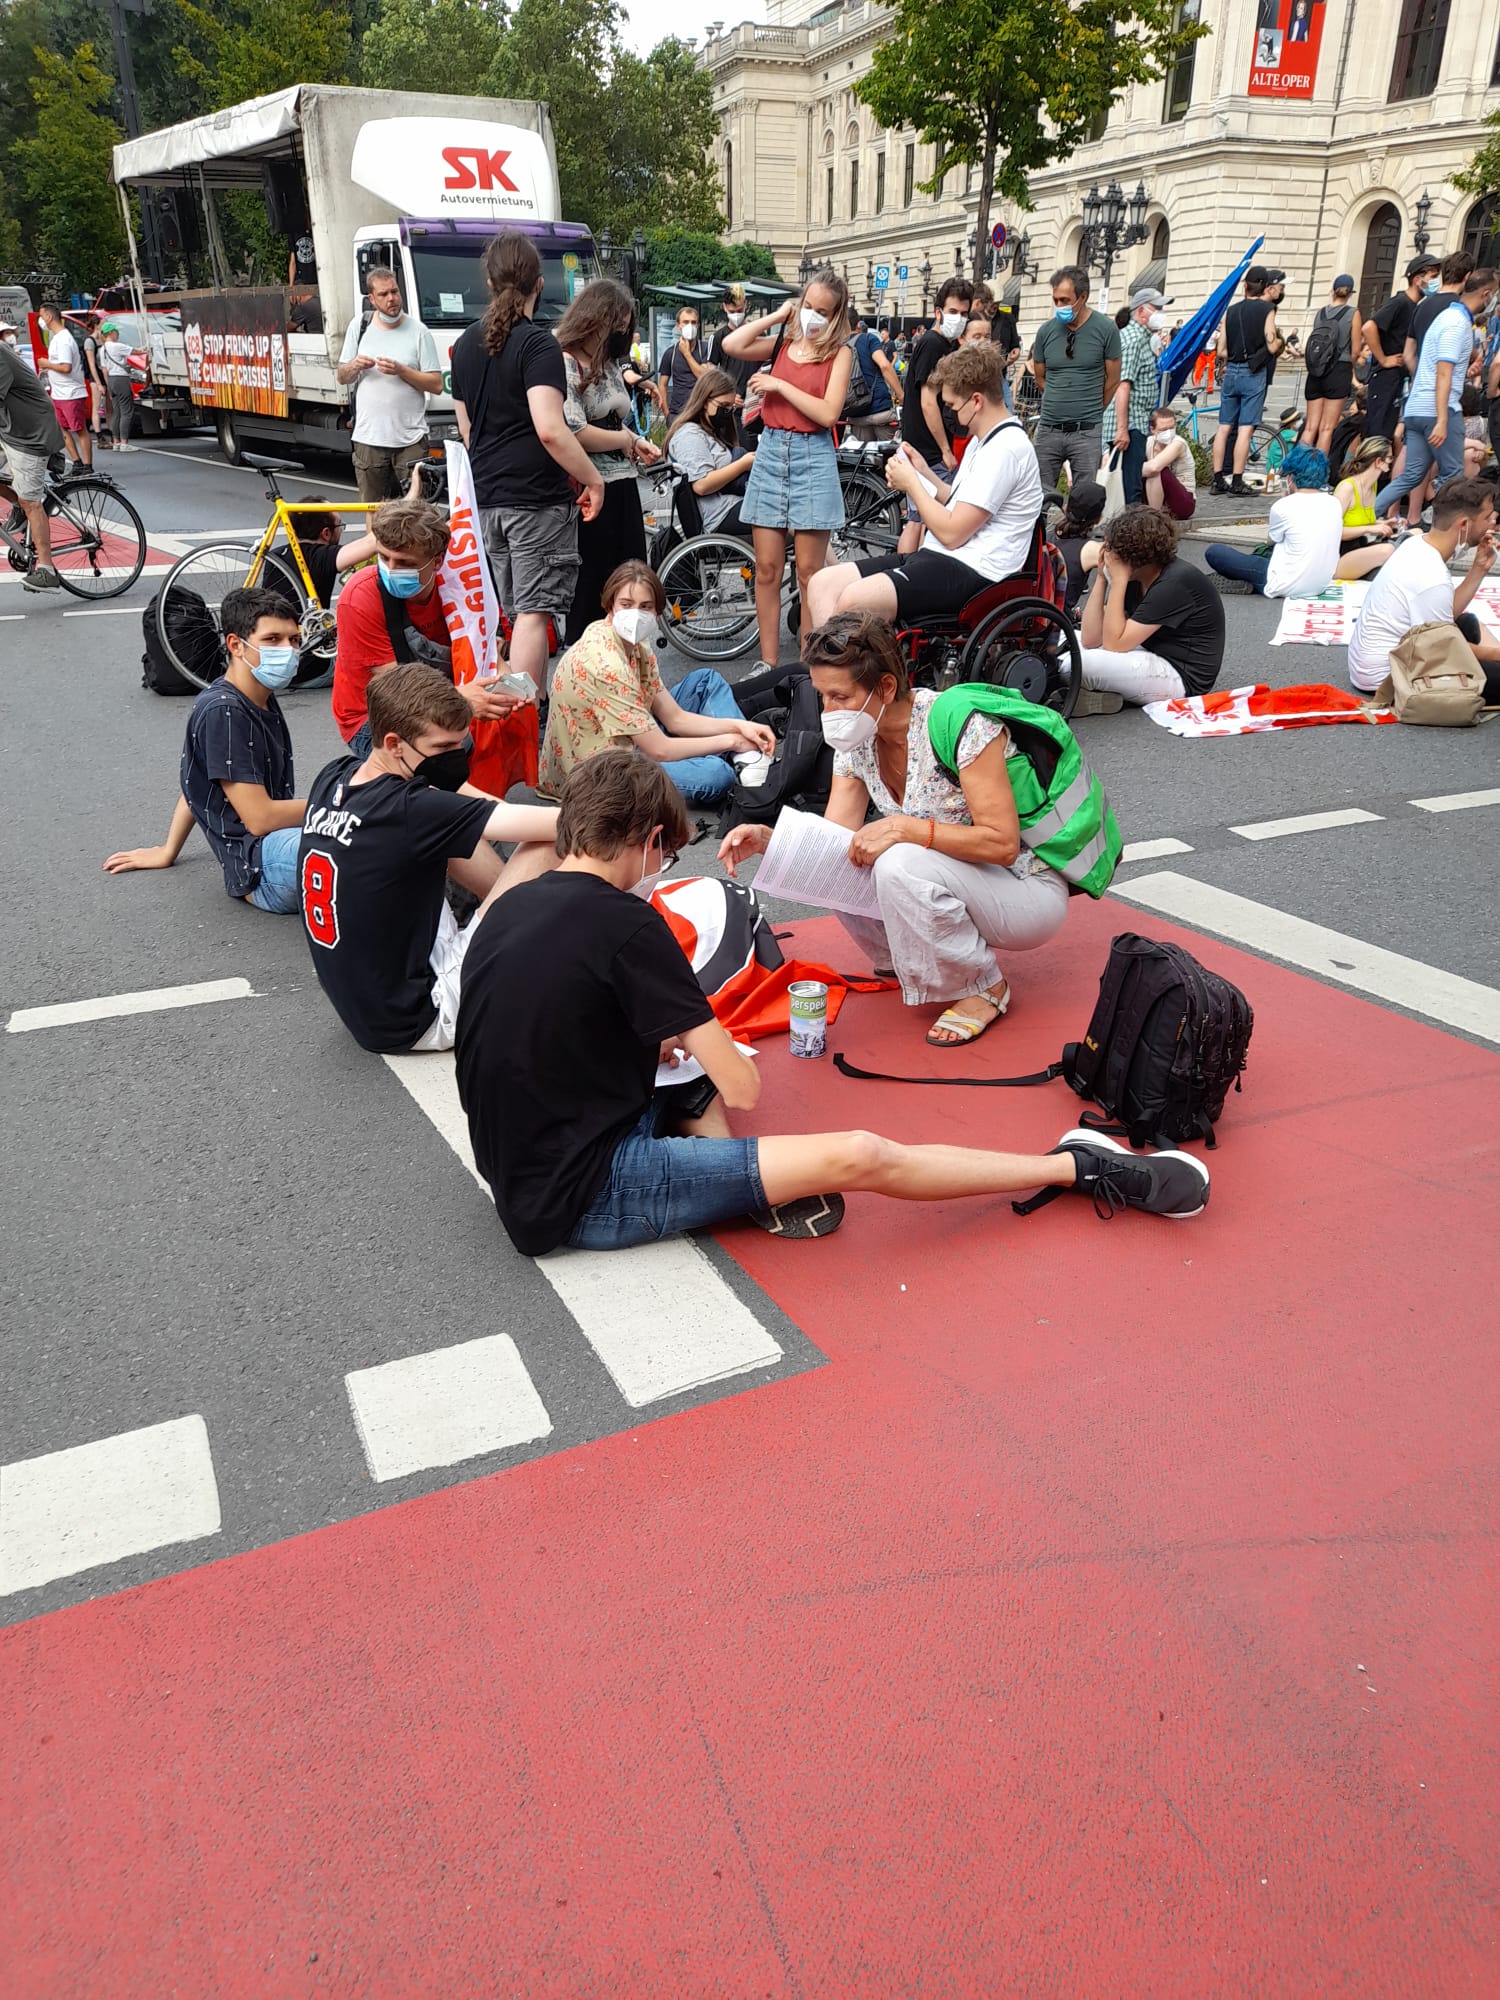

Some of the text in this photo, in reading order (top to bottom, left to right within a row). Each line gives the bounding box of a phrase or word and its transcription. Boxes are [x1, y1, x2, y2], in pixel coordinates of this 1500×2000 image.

[1251, 72, 1310, 88] ALTE OPER
[442, 147, 520, 192] SK
[441, 194, 534, 209] Autovermietung
[204, 335, 269, 357] STOP FIRING UP
[188, 362, 270, 389] THE CLIMATE CRISIS!
[302, 849, 341, 949] 8
